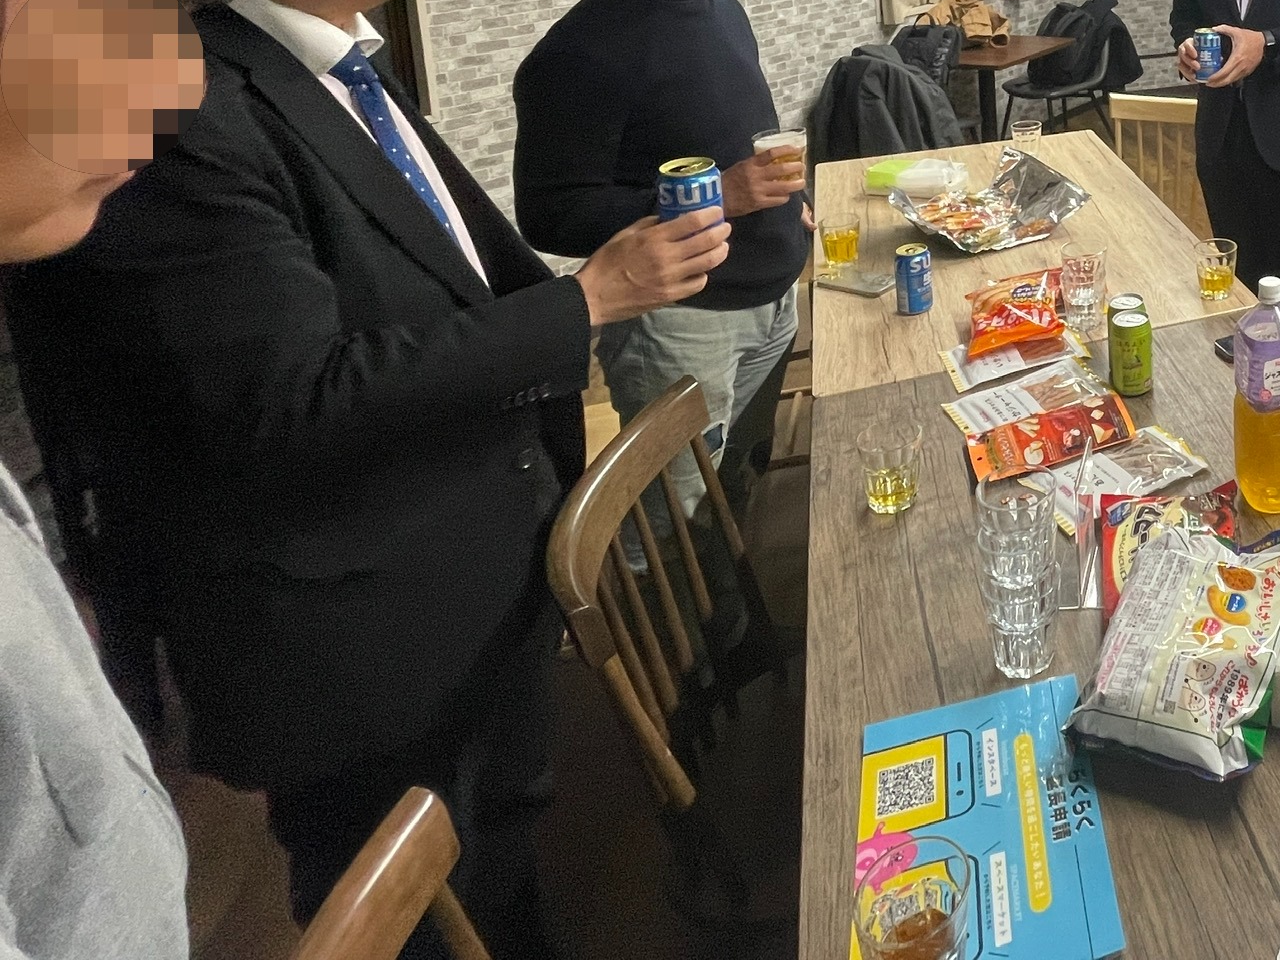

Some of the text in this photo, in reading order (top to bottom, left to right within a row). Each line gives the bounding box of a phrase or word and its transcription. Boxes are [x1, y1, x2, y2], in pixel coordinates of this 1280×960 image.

[1200, 51, 1211, 61] 生
[986, 736, 998, 787] インスタベース
[1068, 769, 1096, 831] らくらく
[993, 859, 1008, 938] スペースマーケット
